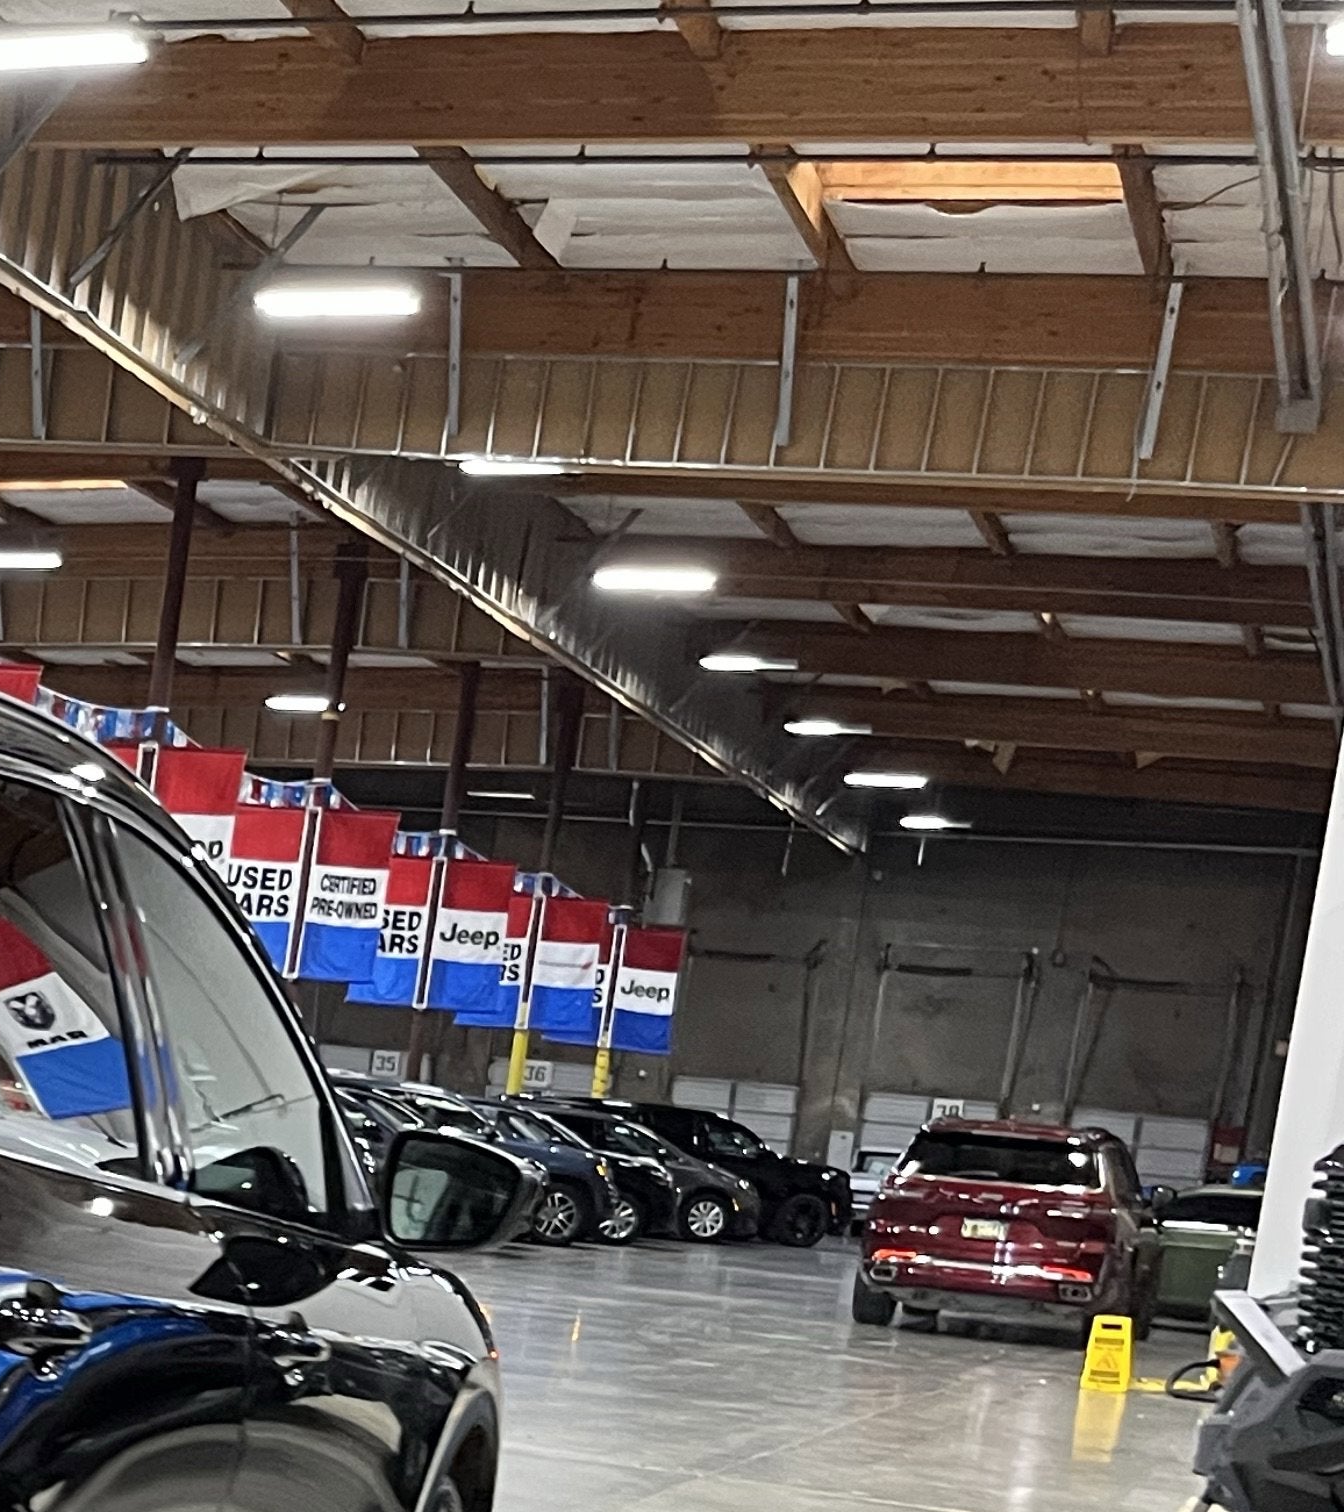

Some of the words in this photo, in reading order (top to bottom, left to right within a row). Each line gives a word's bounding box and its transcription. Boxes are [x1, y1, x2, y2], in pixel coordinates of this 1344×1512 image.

[227, 863, 292, 890] USED
[320, 873, 377, 895] CERTIFIED
[240, 892, 290, 917] ARS
[312, 896, 378, 920] PRE-OWNED
[380, 908, 422, 931] SED
[439, 923, 500, 950] Jeep
[620, 979, 670, 1003] Jeep
[375, 1055, 396, 1072] 35
[524, 1065, 547, 1082] 36
